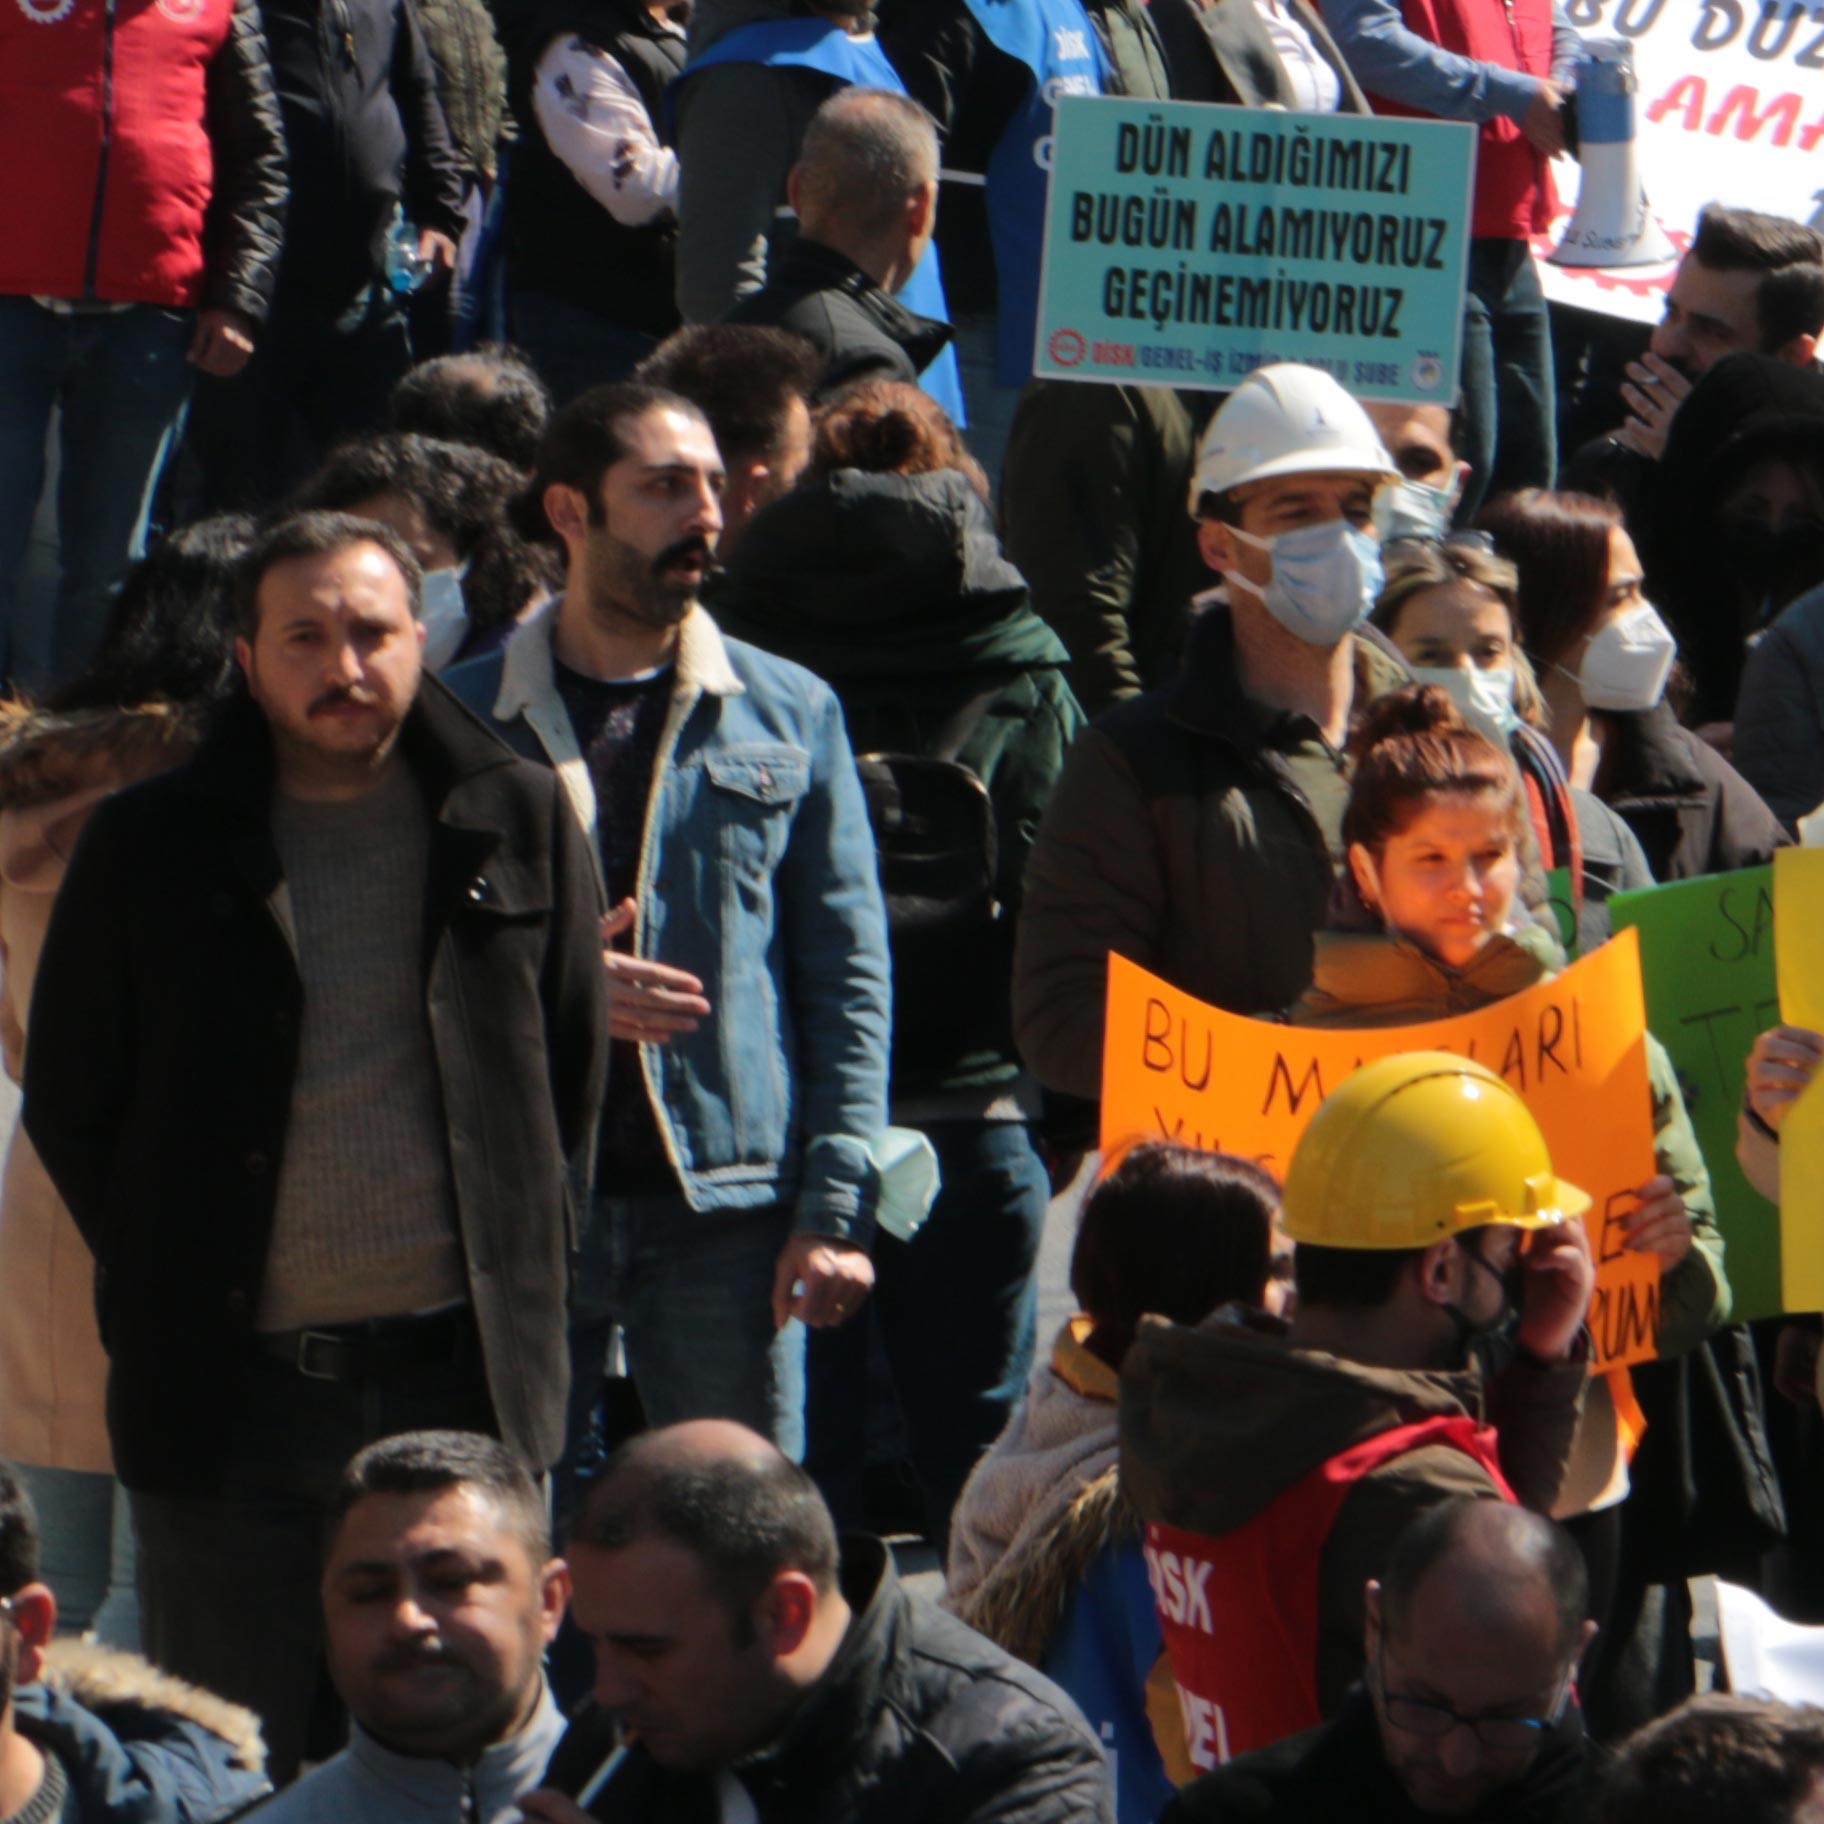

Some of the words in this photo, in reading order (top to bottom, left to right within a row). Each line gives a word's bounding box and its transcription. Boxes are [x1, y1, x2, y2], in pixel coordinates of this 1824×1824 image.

[1116, 113, 1193, 178] DÜN
[1204, 124, 1412, 195] ALDIĞIMIZI
[1070, 185, 1198, 251] BUGÜN
[1210, 202, 1448, 270] ALAMIYORUZ
[1102, 261, 1405, 339] GEÇİNEMİYORUZ
[1142, 997, 1214, 1093] BU
[1260, 993, 1584, 1118] MARI
